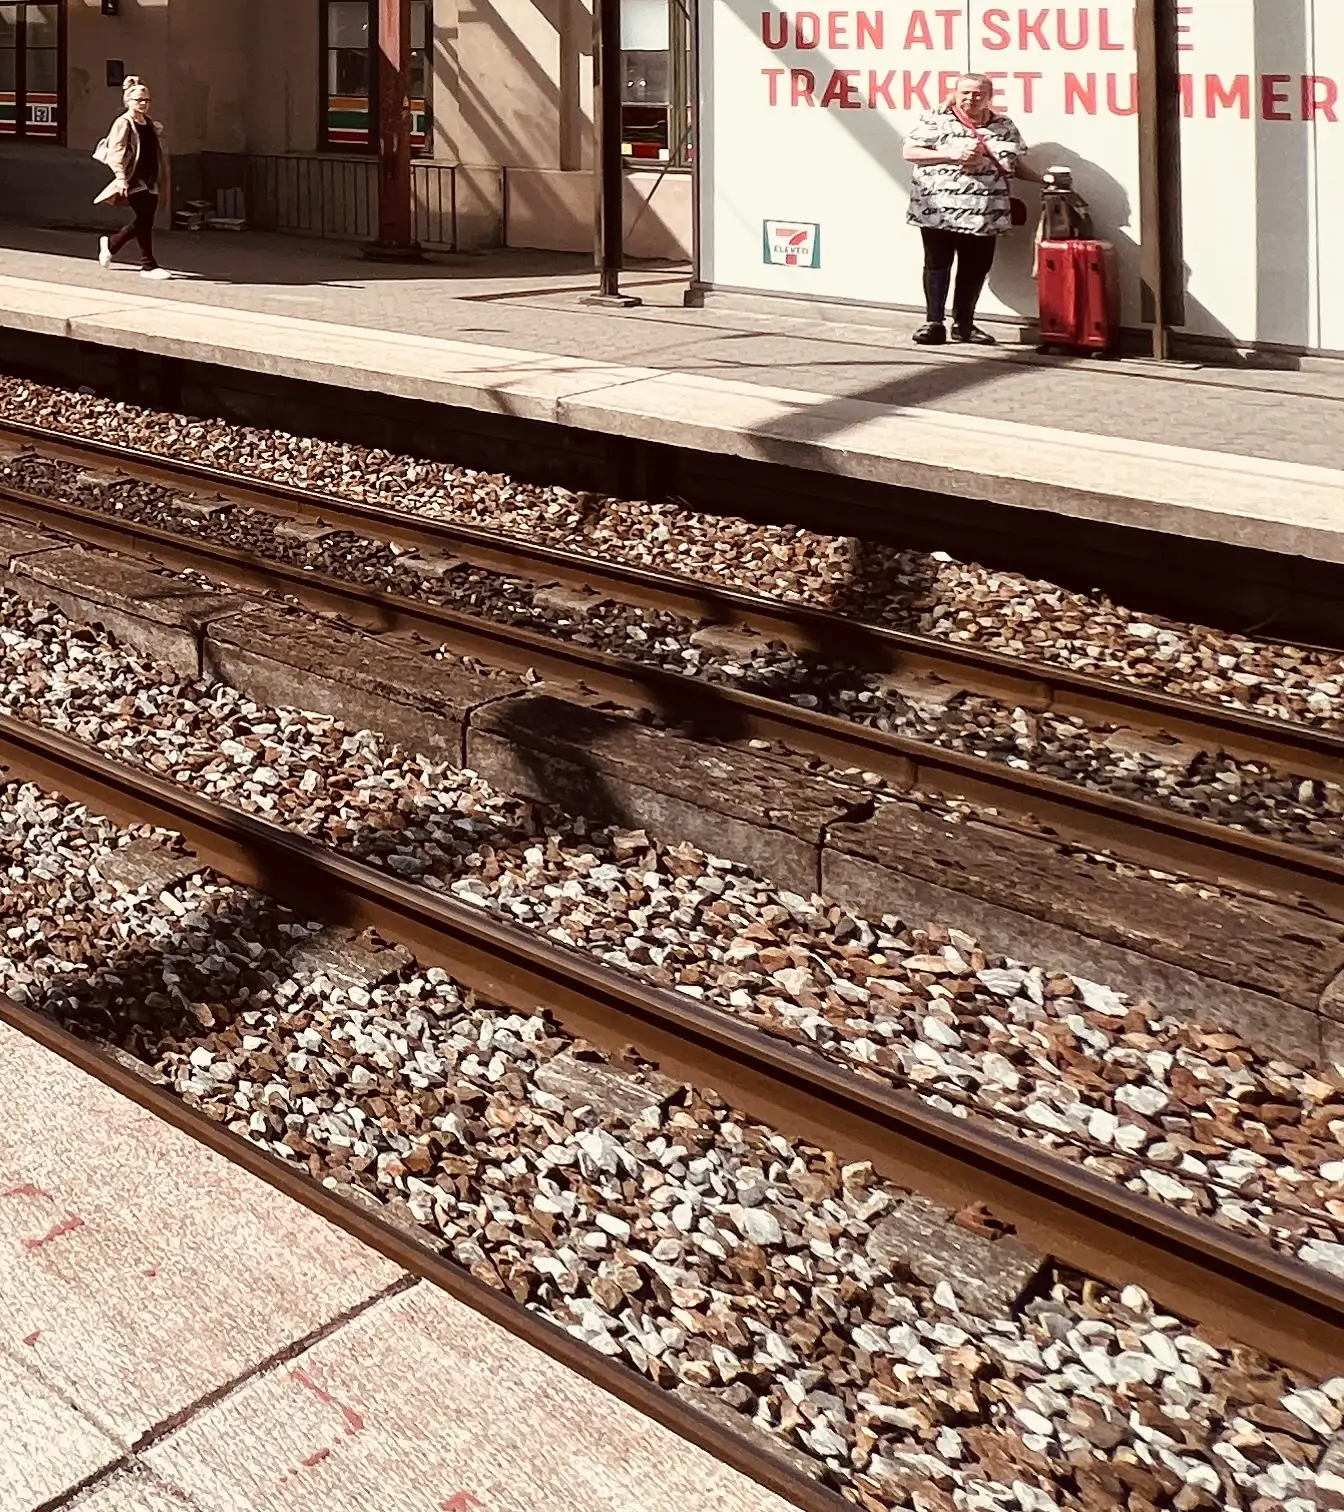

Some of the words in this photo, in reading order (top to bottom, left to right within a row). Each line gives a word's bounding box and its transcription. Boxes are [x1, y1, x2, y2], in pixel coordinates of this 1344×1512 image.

[761, 10, 884, 50] UDEN
[902, 9, 962, 51] AT
[981, 6, 1195, 52] SKULE
